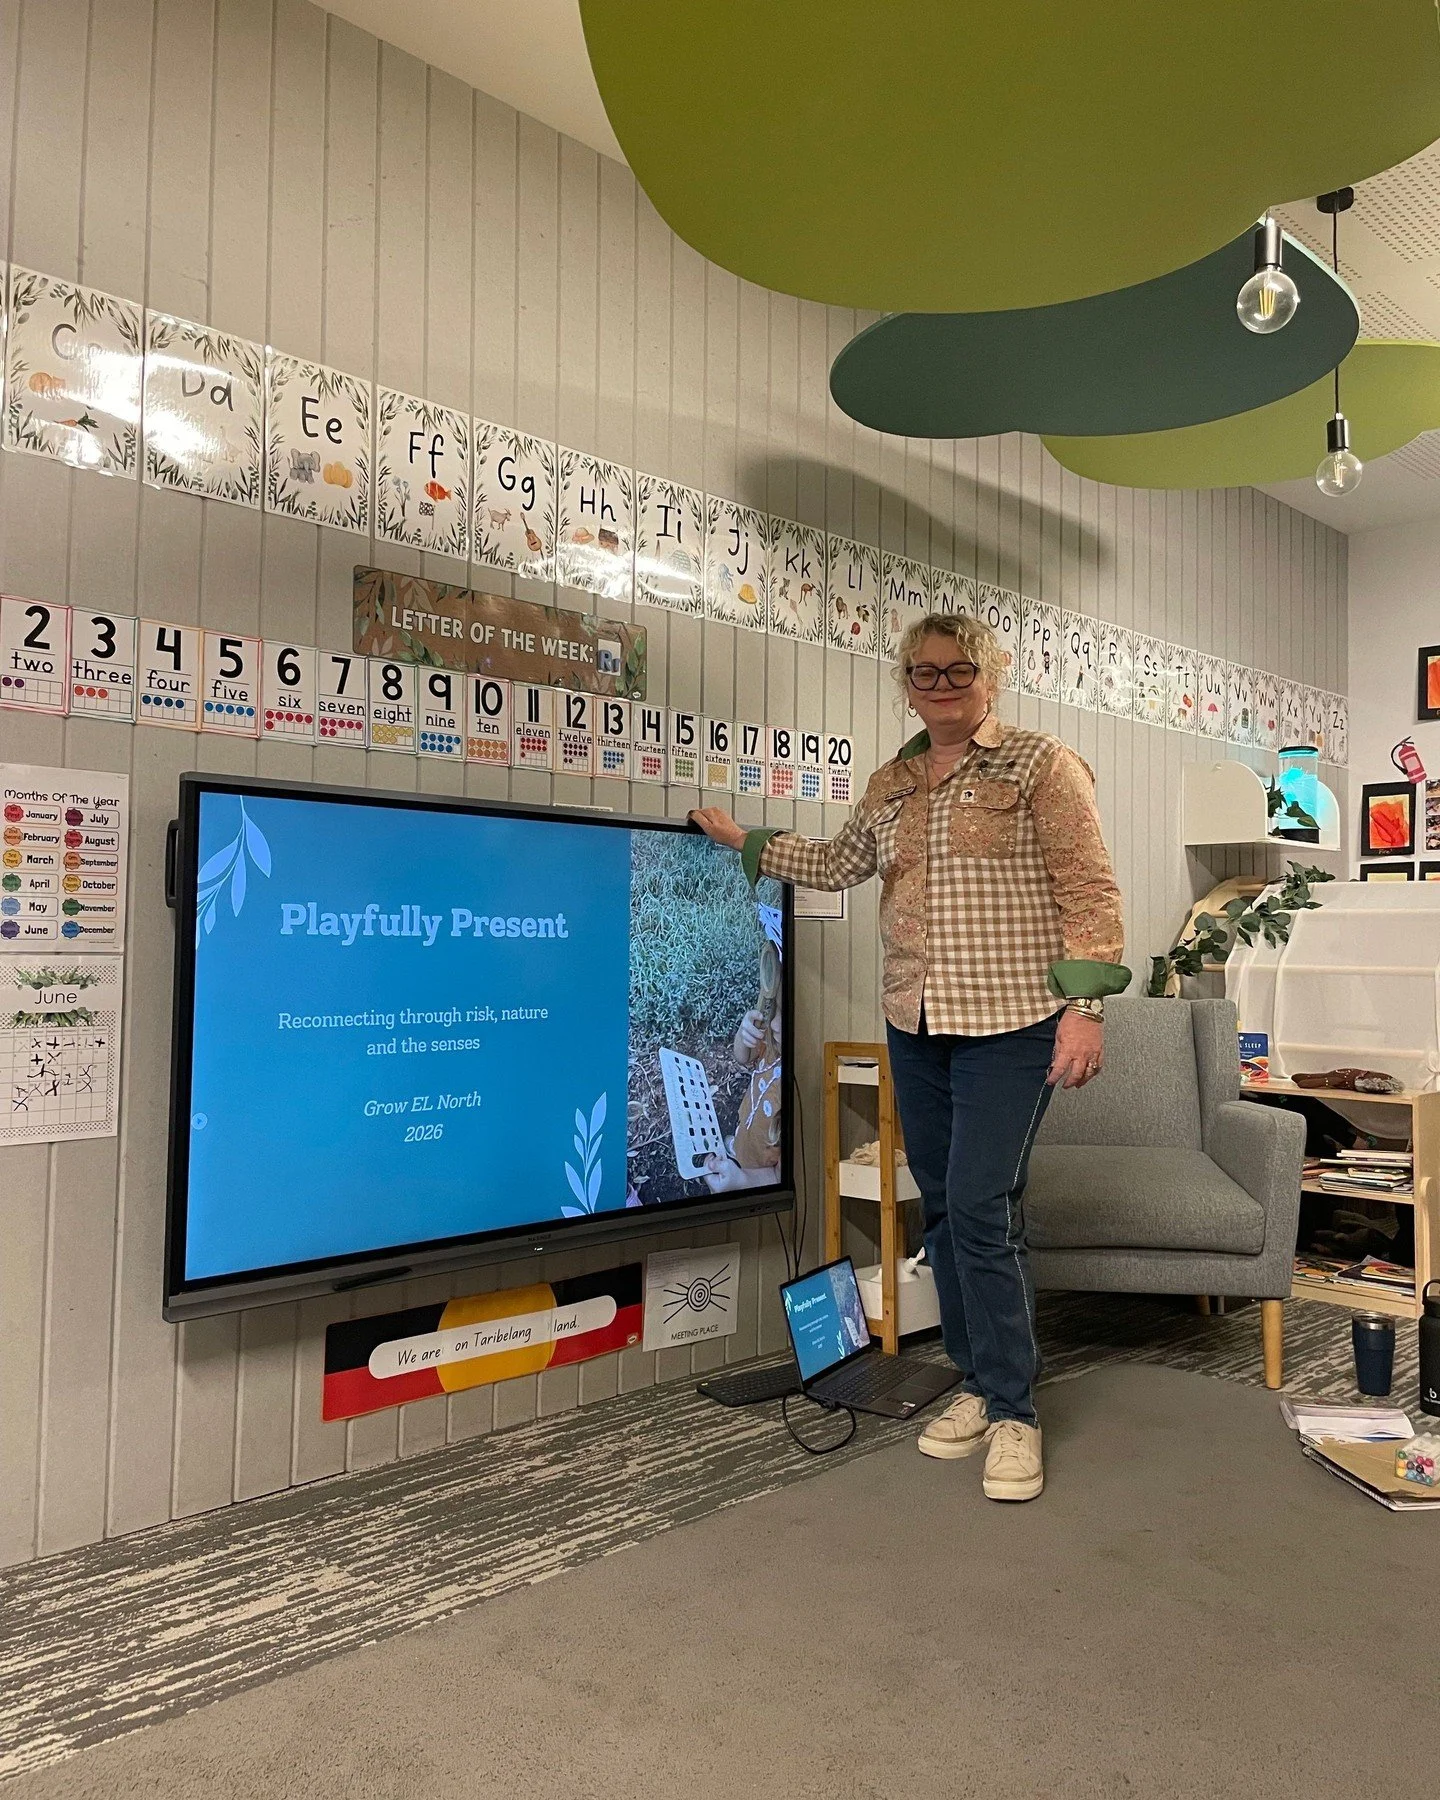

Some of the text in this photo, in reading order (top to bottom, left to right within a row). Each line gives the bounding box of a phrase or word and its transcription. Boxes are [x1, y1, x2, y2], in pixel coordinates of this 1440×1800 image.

[300, 396, 343, 445] Ee
[408, 431, 445, 479] Ff
[497, 456, 536, 511] Gg
[580, 486, 617, 522] Hh
[656, 504, 682, 544] Ii
[727, 527, 749, 575] Jj
[785, 547, 812, 579] Kk
[848, 563, 863, 591] Ll
[889, 577, 924, 608] Mm
[942, 592, 966, 614] Nn
[24, 605, 51, 650] 2
[988, 605, 1011, 633] Oo
[90, 616, 116, 659] 3
[391, 605, 594, 663] LETTER OF THE WEEK:
[1033, 618, 1051, 654] Pp
[156, 627, 182, 671] 4
[219, 638, 243, 678] 5
[1070, 632, 1092, 670] Qq
[11, 651, 54, 673] two
[72, 660, 132, 685] three
[277, 648, 301, 686] 6
[1144, 654, 1158, 677] Ss
[147, 670, 191, 692] four
[331, 656, 352, 694] 7
[381, 664, 403, 701] 8
[1175, 665, 1190, 688] Tt
[1205, 674, 1221, 696] Uu
[212, 680, 248, 701] five
[278, 694, 301, 709] six
[428, 673, 451, 710] 9
[475, 679, 503, 716] 10
[1234, 685, 1248, 702] Vv
[1258, 691, 1275, 709] Ww
[318, 700, 365, 716] seven
[373, 705, 412, 723] eight
[528, 688, 539, 723] 11
[566, 694, 586, 729] 12
[1286, 699, 1298, 718] Xx
[425, 714, 455, 728] nine
[477, 718, 499, 734] ten
[604, 702, 623, 735] 13
[642, 709, 661, 742] 14
[676, 713, 694, 745] 15
[1309, 705, 1322, 734] Yy
[1332, 711, 1345, 730] Zz
[515, 723, 551, 738] eleven
[558, 729, 592, 744] twelve
[710, 720, 728, 751] 16
[743, 725, 759, 756] 17
[597, 737, 631, 749] thirteen
[634, 742, 666, 754] fourteen
[672, 746, 697, 759] fifteen
[773, 729, 791, 758] 18
[802, 733, 819, 763] 19
[828, 737, 852, 765] 20
[705, 753, 731, 764] sixteen
[736, 756, 765, 766] seventeen
[770, 761, 795, 770] eighteen
[797, 764, 823, 773] nineteen
[828, 766, 852, 777] twenty
[4, 789, 120, 809] Months Of The Year
[25, 810, 58, 821] January
[90, 814, 109, 825] July
[23, 833, 59, 843] February
[85, 836, 115, 847] August
[26, 854, 54, 864] March
[80, 858, 117, 867] September
[29, 879, 50, 890] April
[82, 880, 115, 889] October
[29, 902, 47, 913] May
[80, 904, 115, 912] November
[24, 925, 48, 934] June
[280, 902, 569, 946] Playfully Present
[34, 990, 77, 1004] June
[278, 1005, 548, 1030] Reconnecting through risk, nature
[366, 1036, 480, 1055] and the senses
[363, 1091, 481, 1116] Grow EL North
[404, 1124, 443, 1142] 2026
[398, 1315, 580, 1366] We are on Taribelang land.
[671, 1324, 718, 1340] MEETING PLACE
